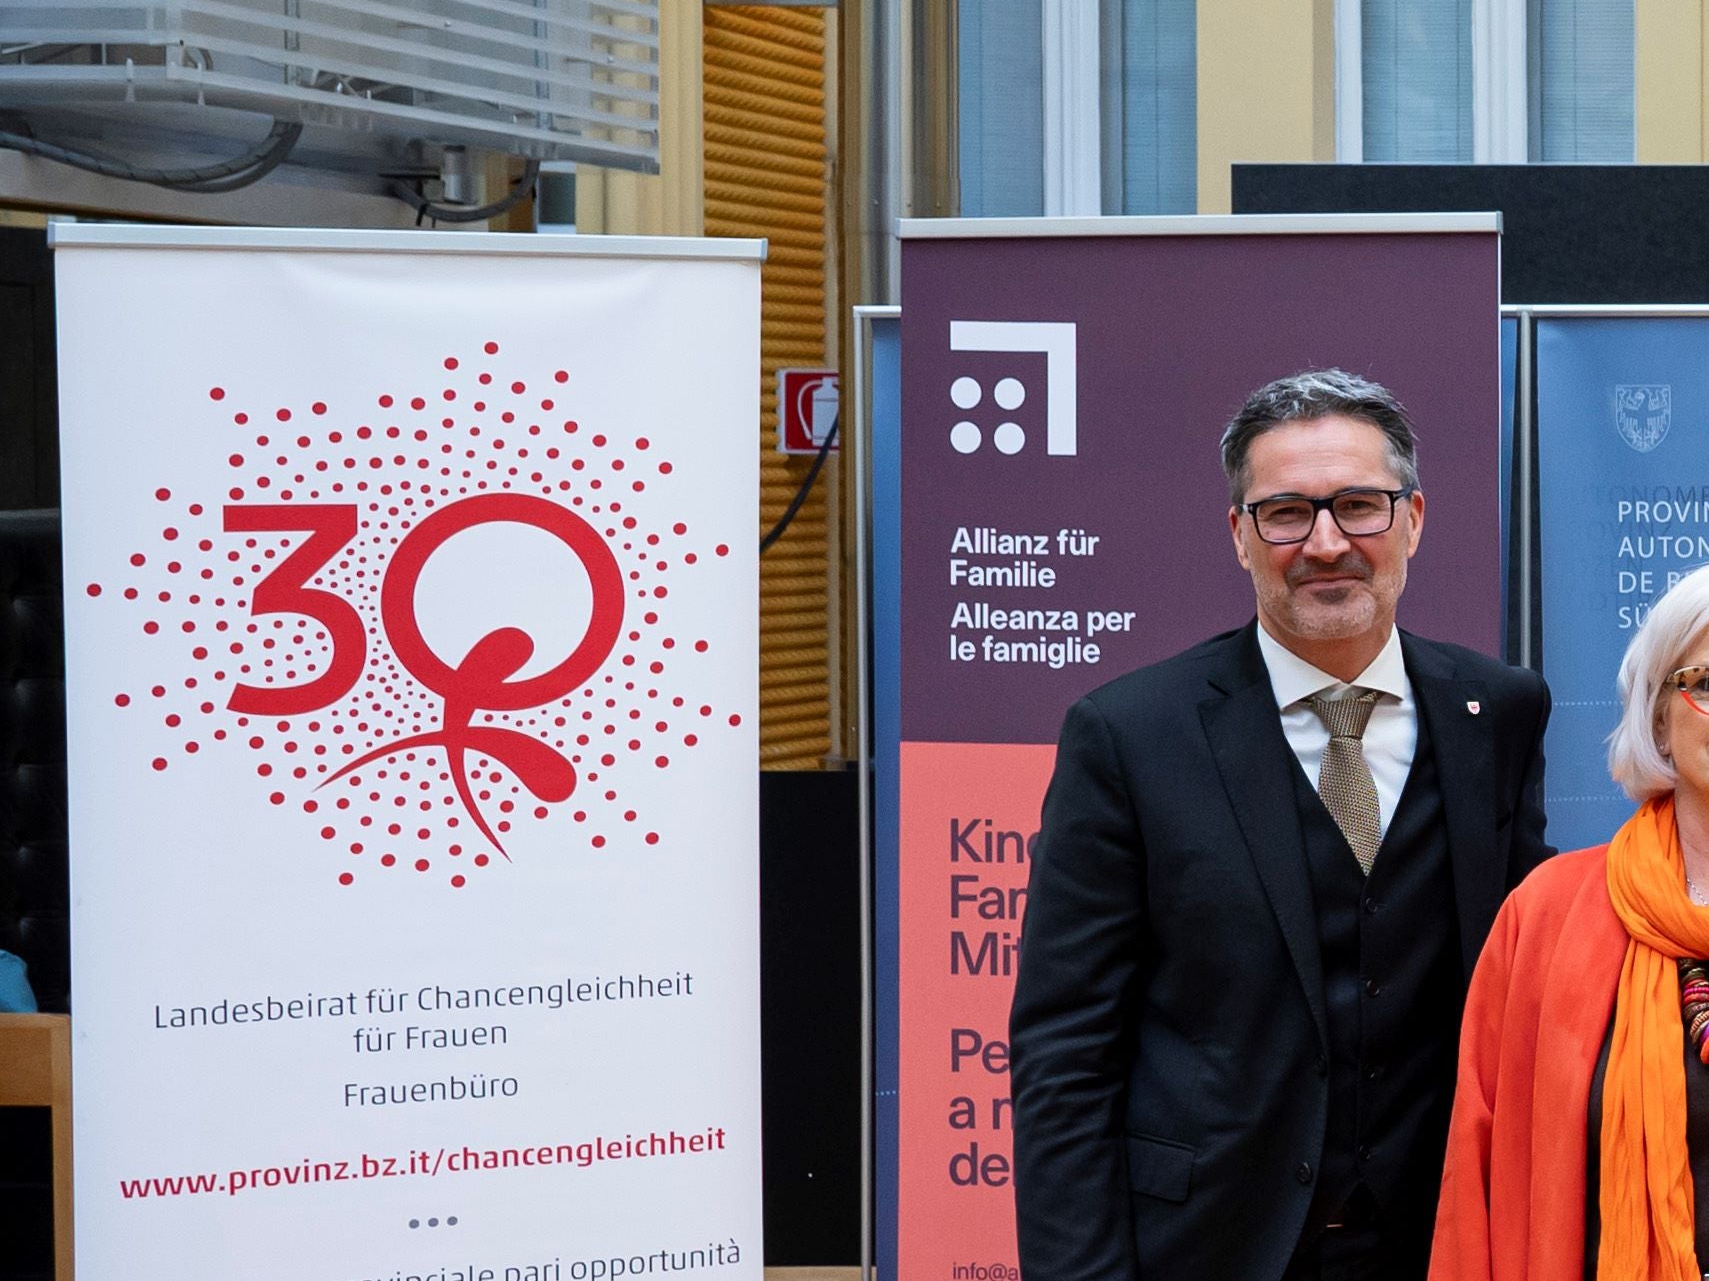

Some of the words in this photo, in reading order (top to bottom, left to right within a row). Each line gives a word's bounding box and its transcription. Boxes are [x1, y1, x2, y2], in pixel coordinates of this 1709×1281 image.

[950, 527, 1049, 556] Allianz
[1057, 528, 1100, 557] für
[949, 560, 1056, 589] Familie
[1619, 571, 1654, 594] DE
[950, 602, 1079, 632] Alleanza
[1086, 609, 1136, 636] per
[949, 634, 976, 662] le
[982, 635, 1101, 670] famiglie
[154, 993, 358, 1029] Landesbeirat
[366, 987, 409, 1015] für
[417, 971, 694, 1013] Chancengleichheit
[353, 1026, 397, 1054] für
[405, 1023, 508, 1051] Frauen
[343, 1073, 520, 1108] Frauenbüro
[948, 1096, 976, 1130] a
[120, 1126, 727, 1199] www.provinz.bz.it/chancengleichheit
[948, 1141, 1015, 1186] de
